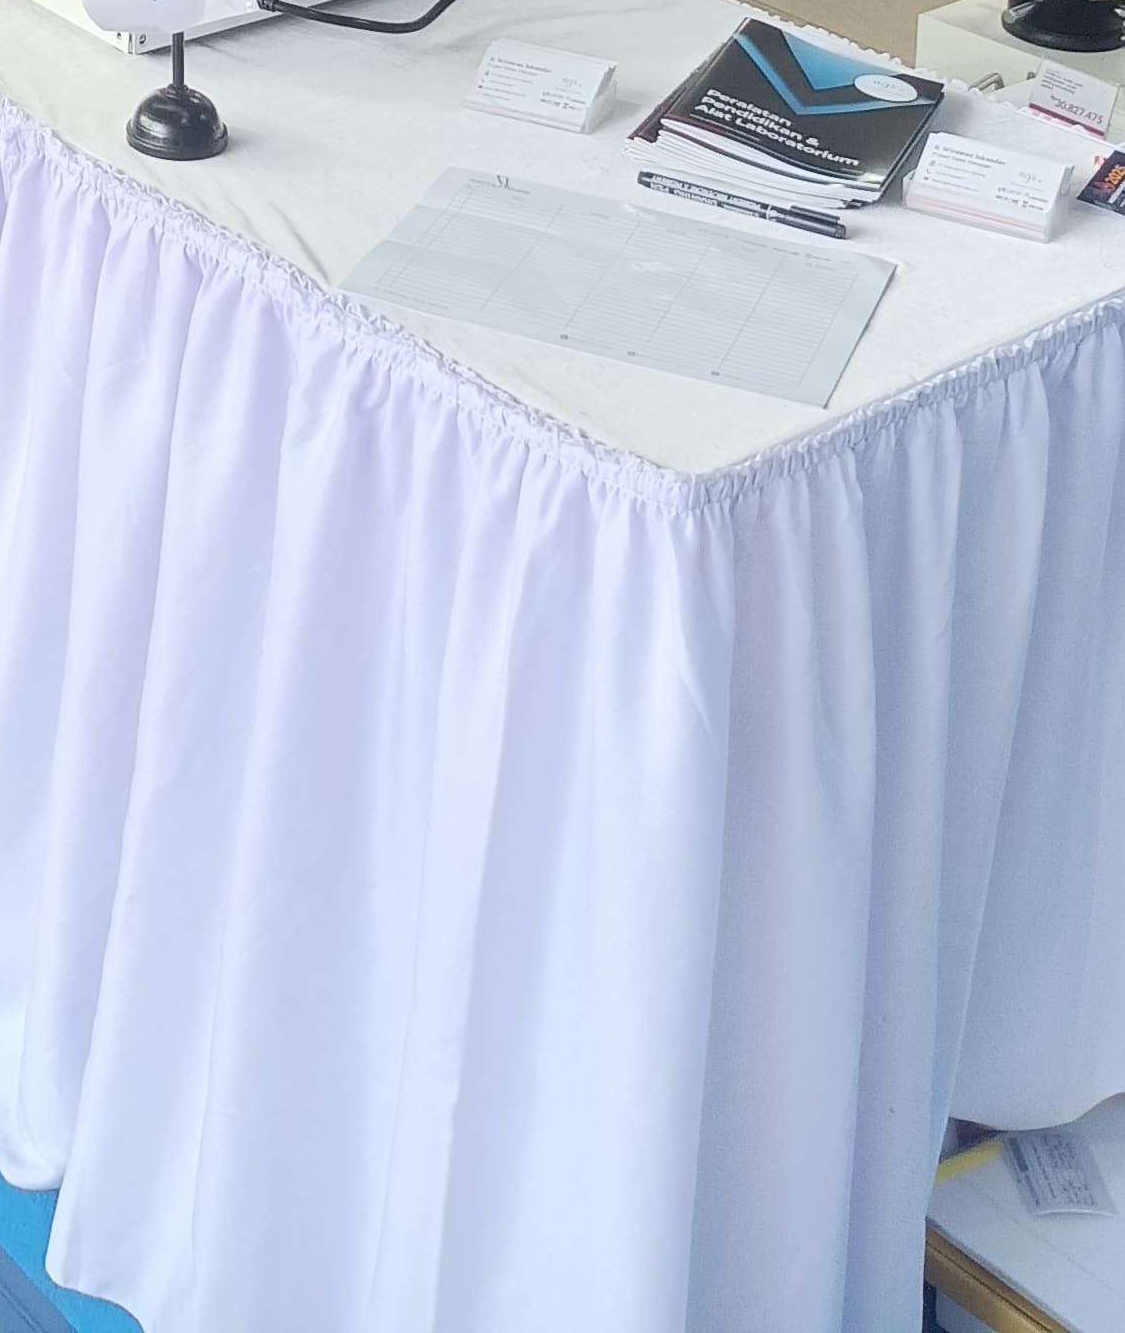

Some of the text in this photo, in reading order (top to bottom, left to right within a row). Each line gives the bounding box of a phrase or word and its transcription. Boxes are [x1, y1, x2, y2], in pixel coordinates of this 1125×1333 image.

[700, 95, 820, 148] Pendidikan &
[705, 88, 793, 127] Peralatan
[693, 104, 860, 167] Alat Laboratorium
